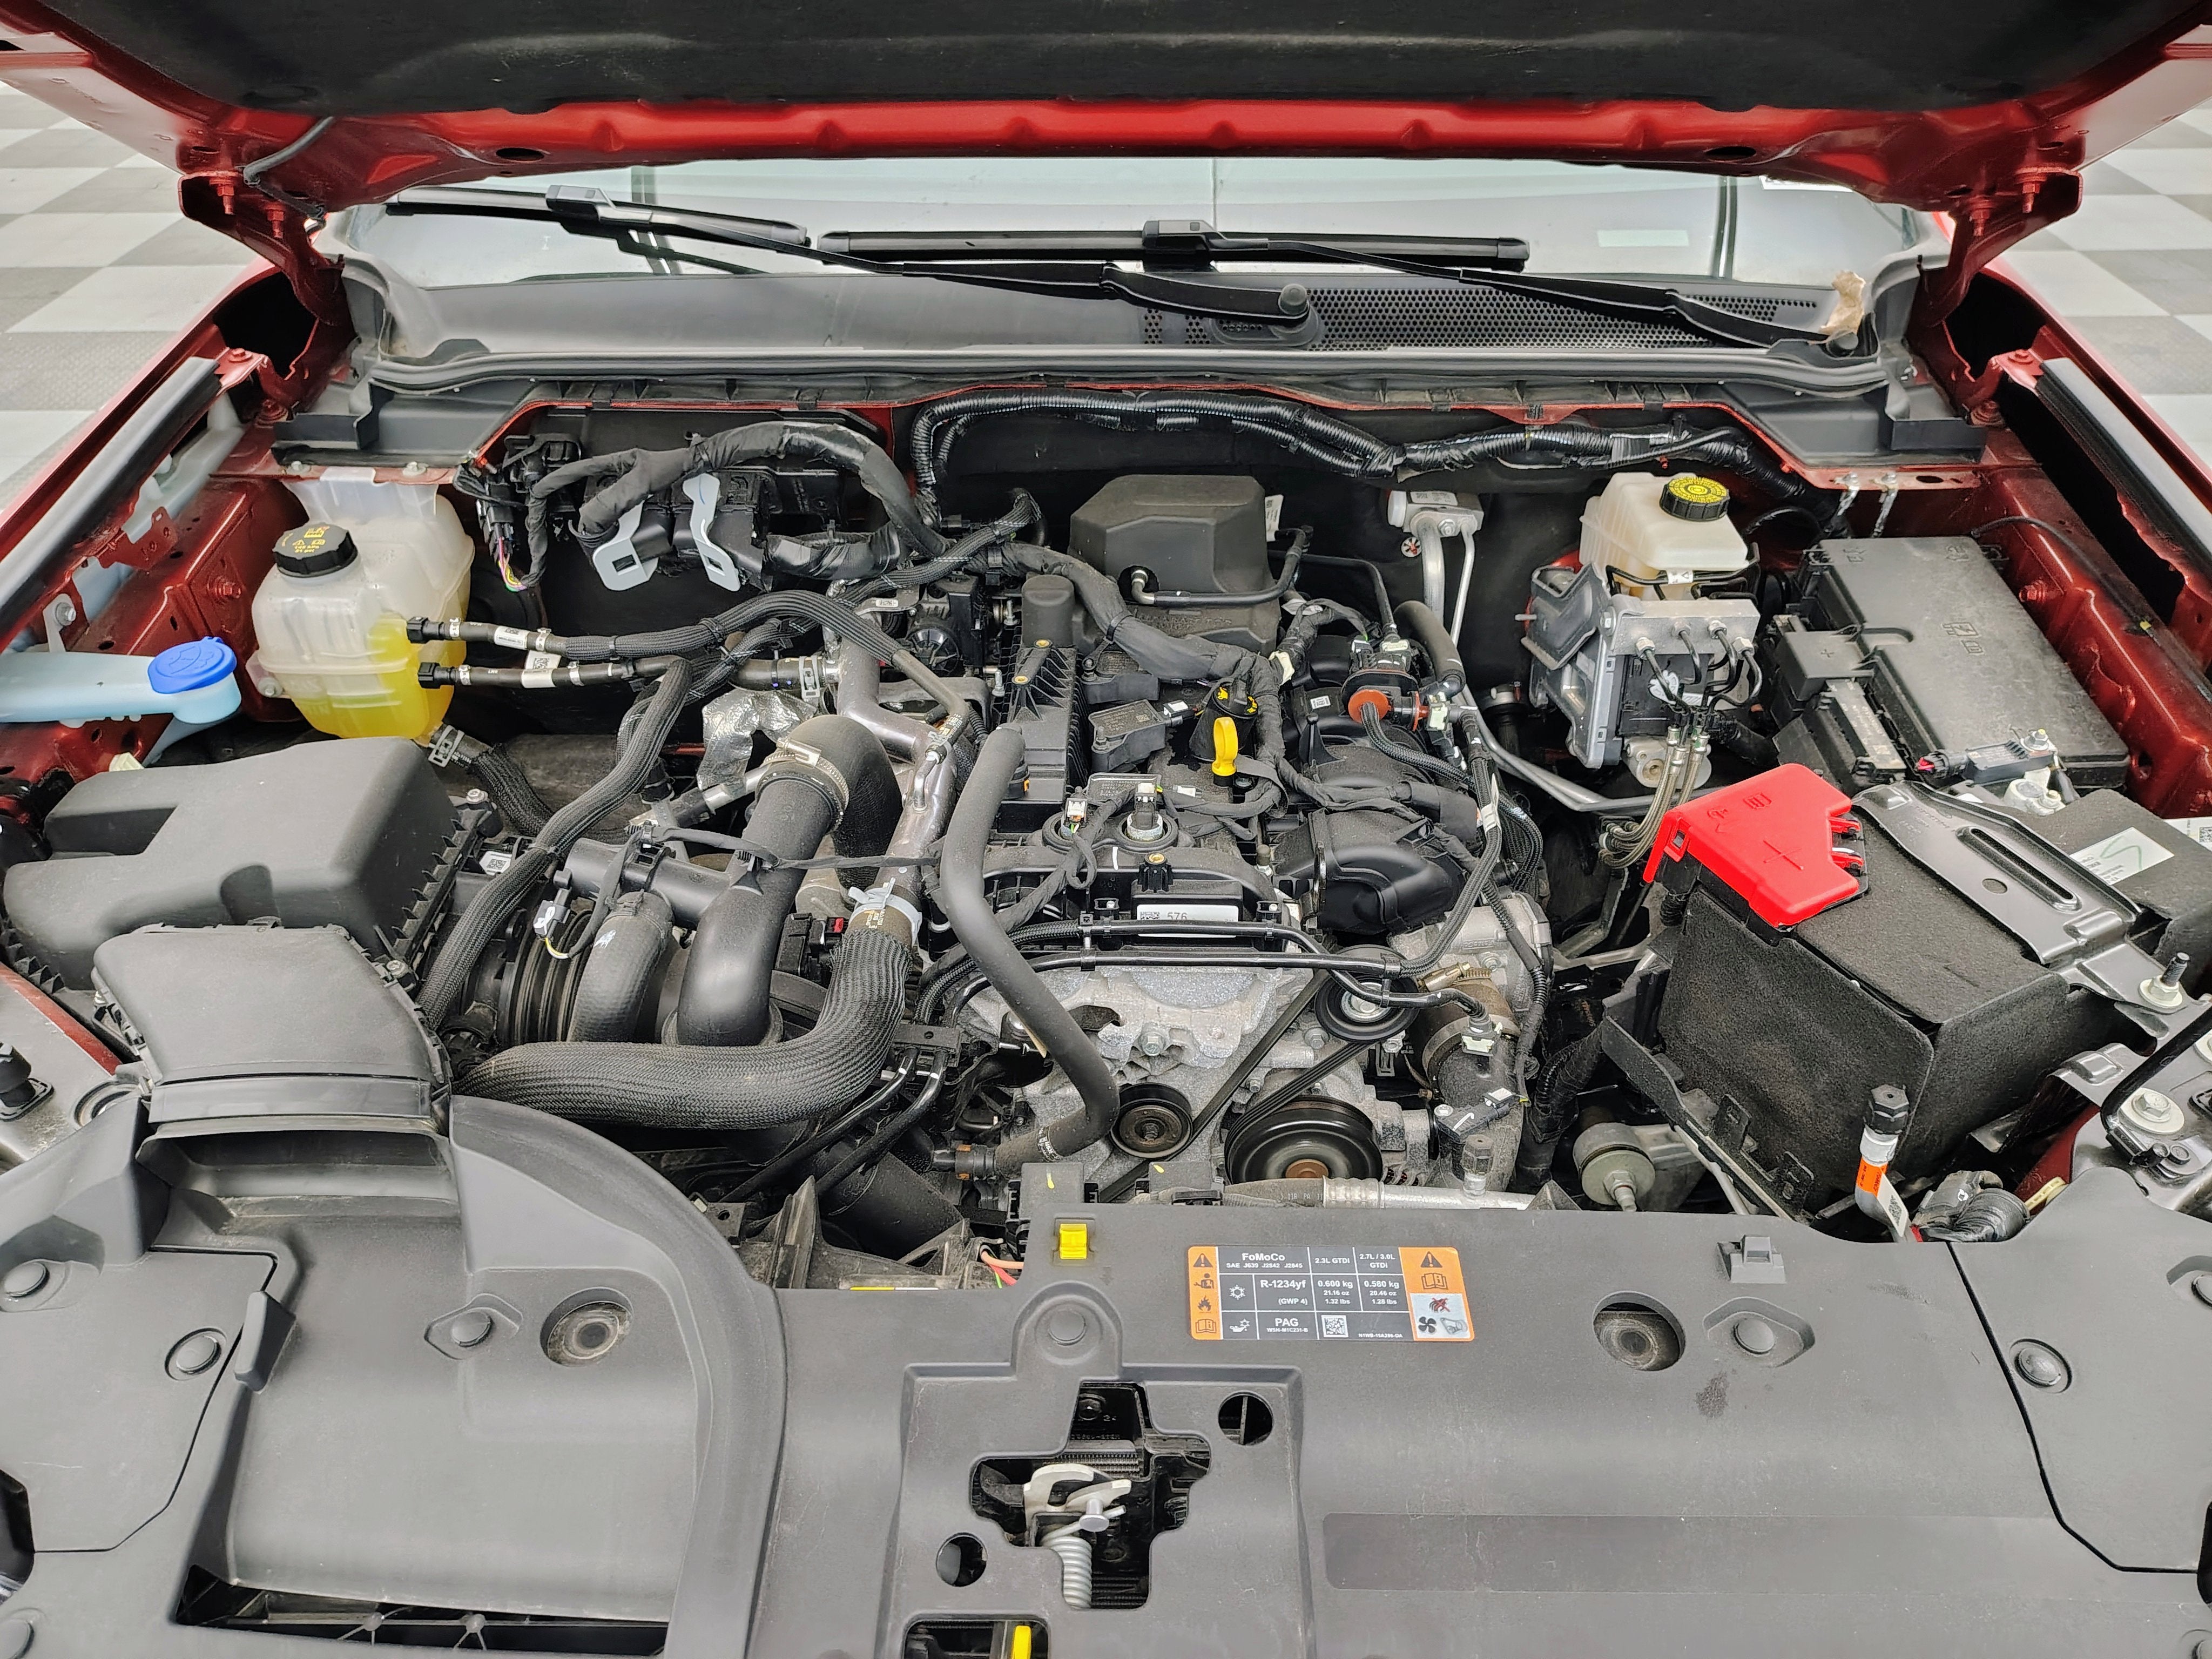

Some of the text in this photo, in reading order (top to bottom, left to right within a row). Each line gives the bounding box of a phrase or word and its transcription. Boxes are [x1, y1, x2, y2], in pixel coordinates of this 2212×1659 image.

[1167, 912, 1188, 920] 576
[1242, 1253, 1285, 1261] FoMoCo
[1260, 1279, 1306, 1290] R-1234yf
[1342, 1280, 1353, 1289] kg
[1388, 1280, 1400, 1289] kg
[1278, 1298, 1308, 1306] (GWP 4)
[1274, 1318, 1299, 1327] PAG
